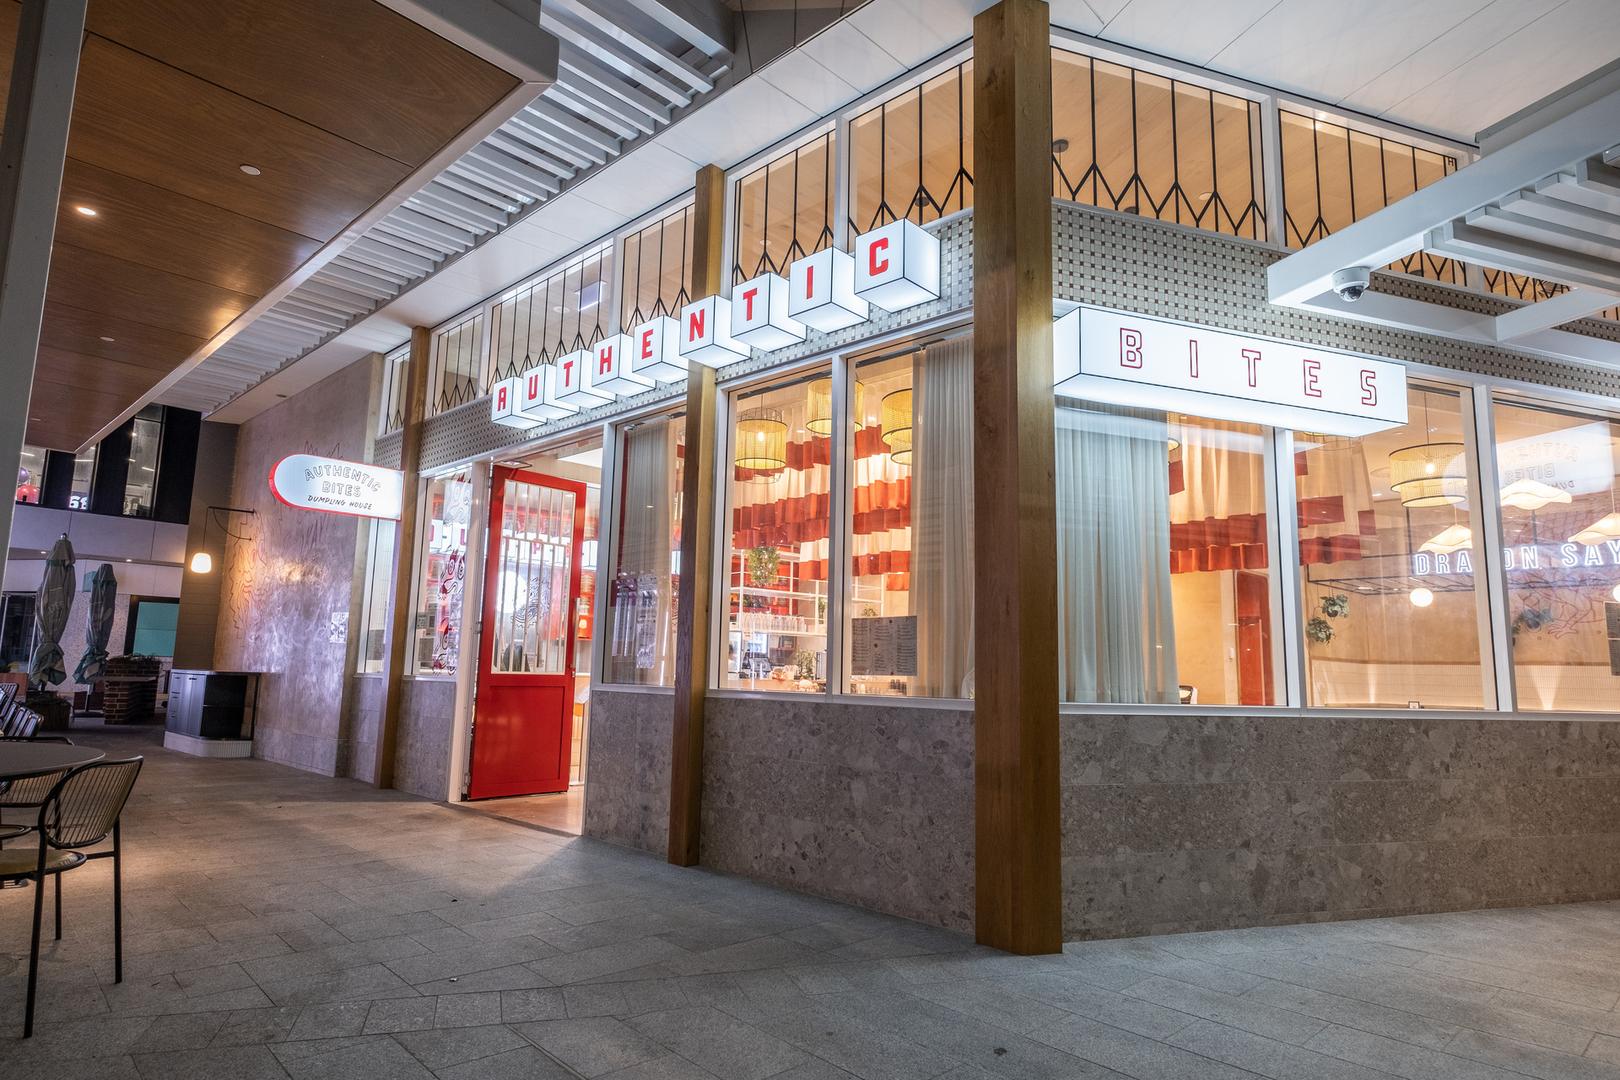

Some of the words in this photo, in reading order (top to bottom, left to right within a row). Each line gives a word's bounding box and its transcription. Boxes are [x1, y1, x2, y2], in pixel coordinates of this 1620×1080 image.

[498, 237, 888, 412] AUTHENTIC
[1120, 327, 1377, 407] BITES
[304, 464, 381, 492] AUTHENTIC
[322, 481, 361, 498] BITES
[307, 494, 346, 506] DUMPLING
[349, 501, 373, 510] HOUSE
[1415, 545, 1539, 576] DRAON
